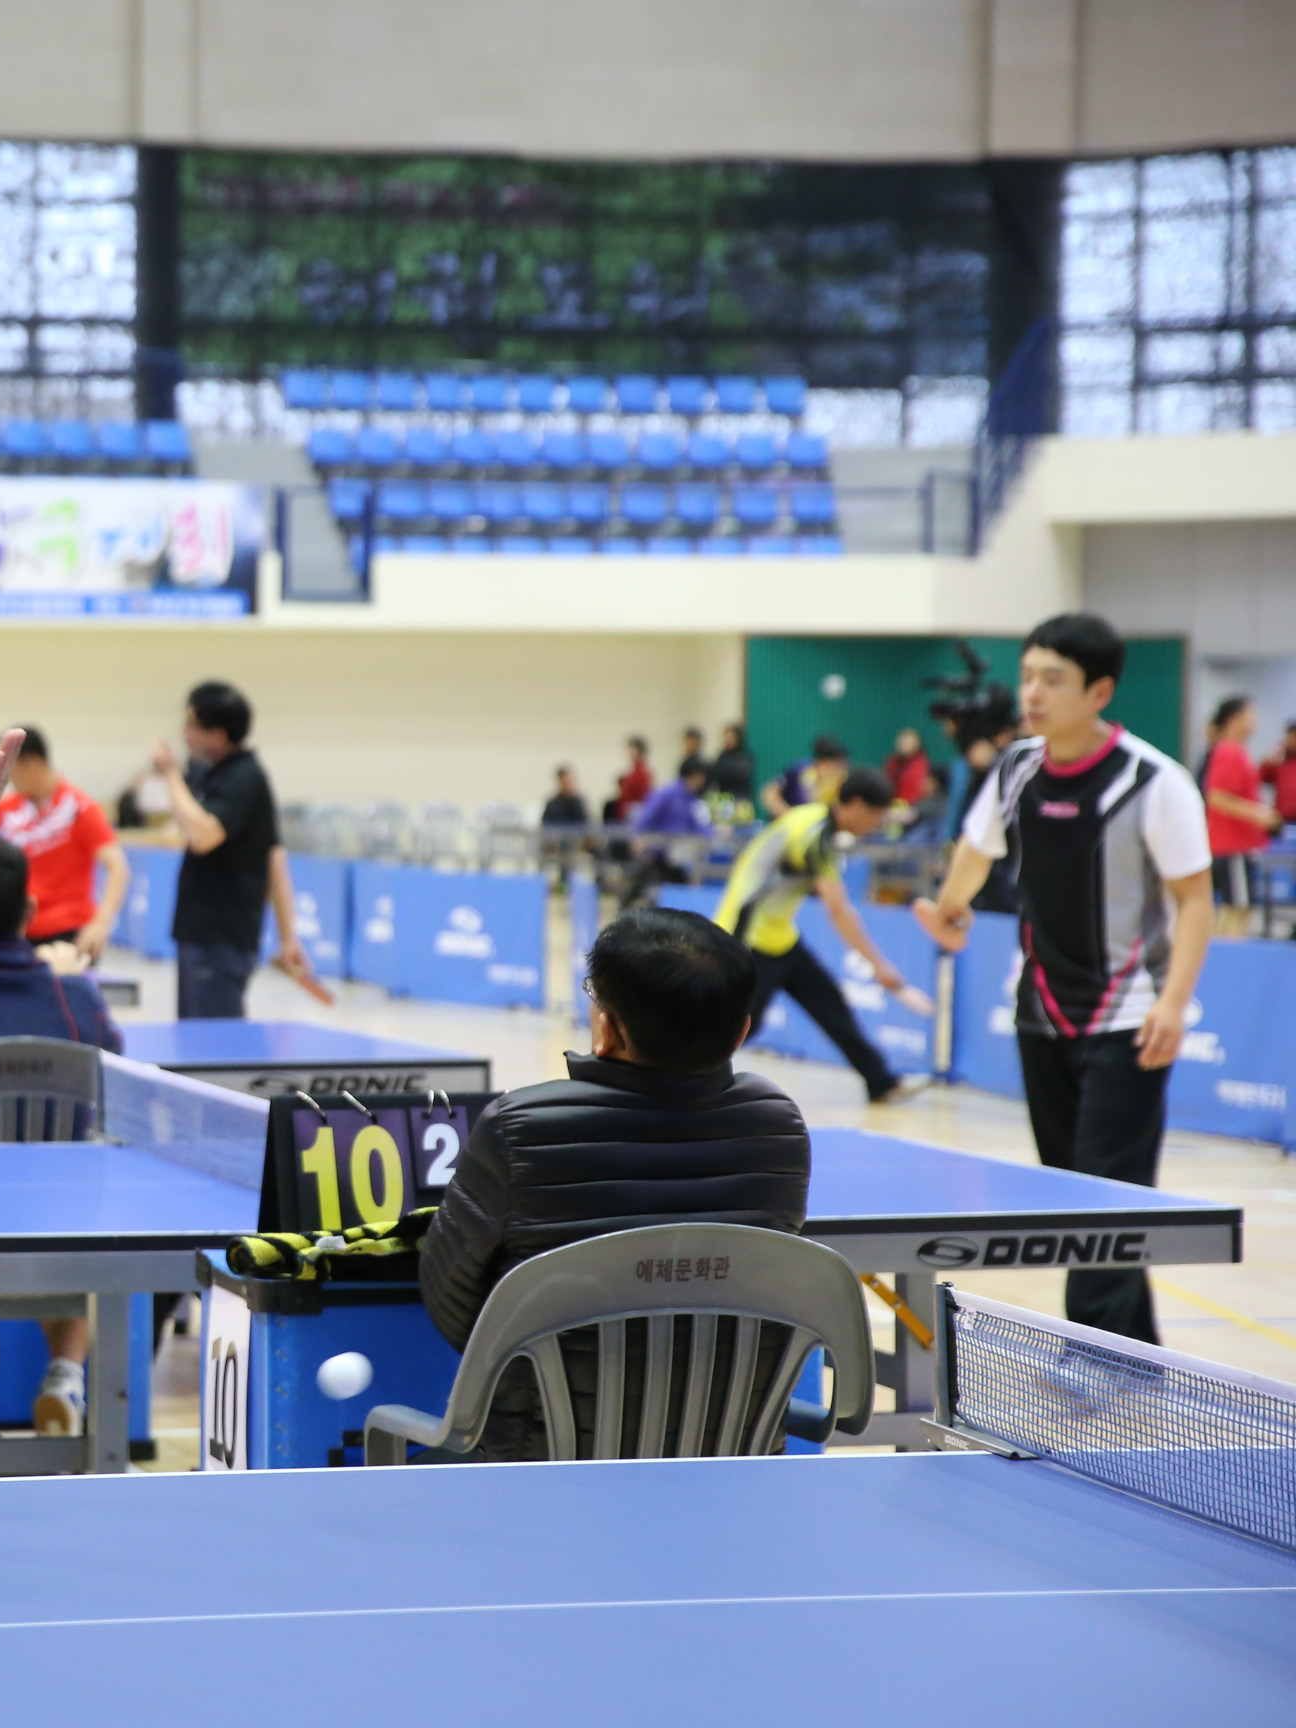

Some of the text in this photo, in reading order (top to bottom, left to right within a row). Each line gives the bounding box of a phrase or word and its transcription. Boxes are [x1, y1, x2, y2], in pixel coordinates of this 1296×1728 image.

[301, 1122, 460, 1231] 10 2
[982, 1232, 1147, 1266] DONIC
[635, 1256, 731, 1283] 예체문화관
[209, 1336, 239, 1469] 10
[945, 1434, 970, 1450] DONIC
